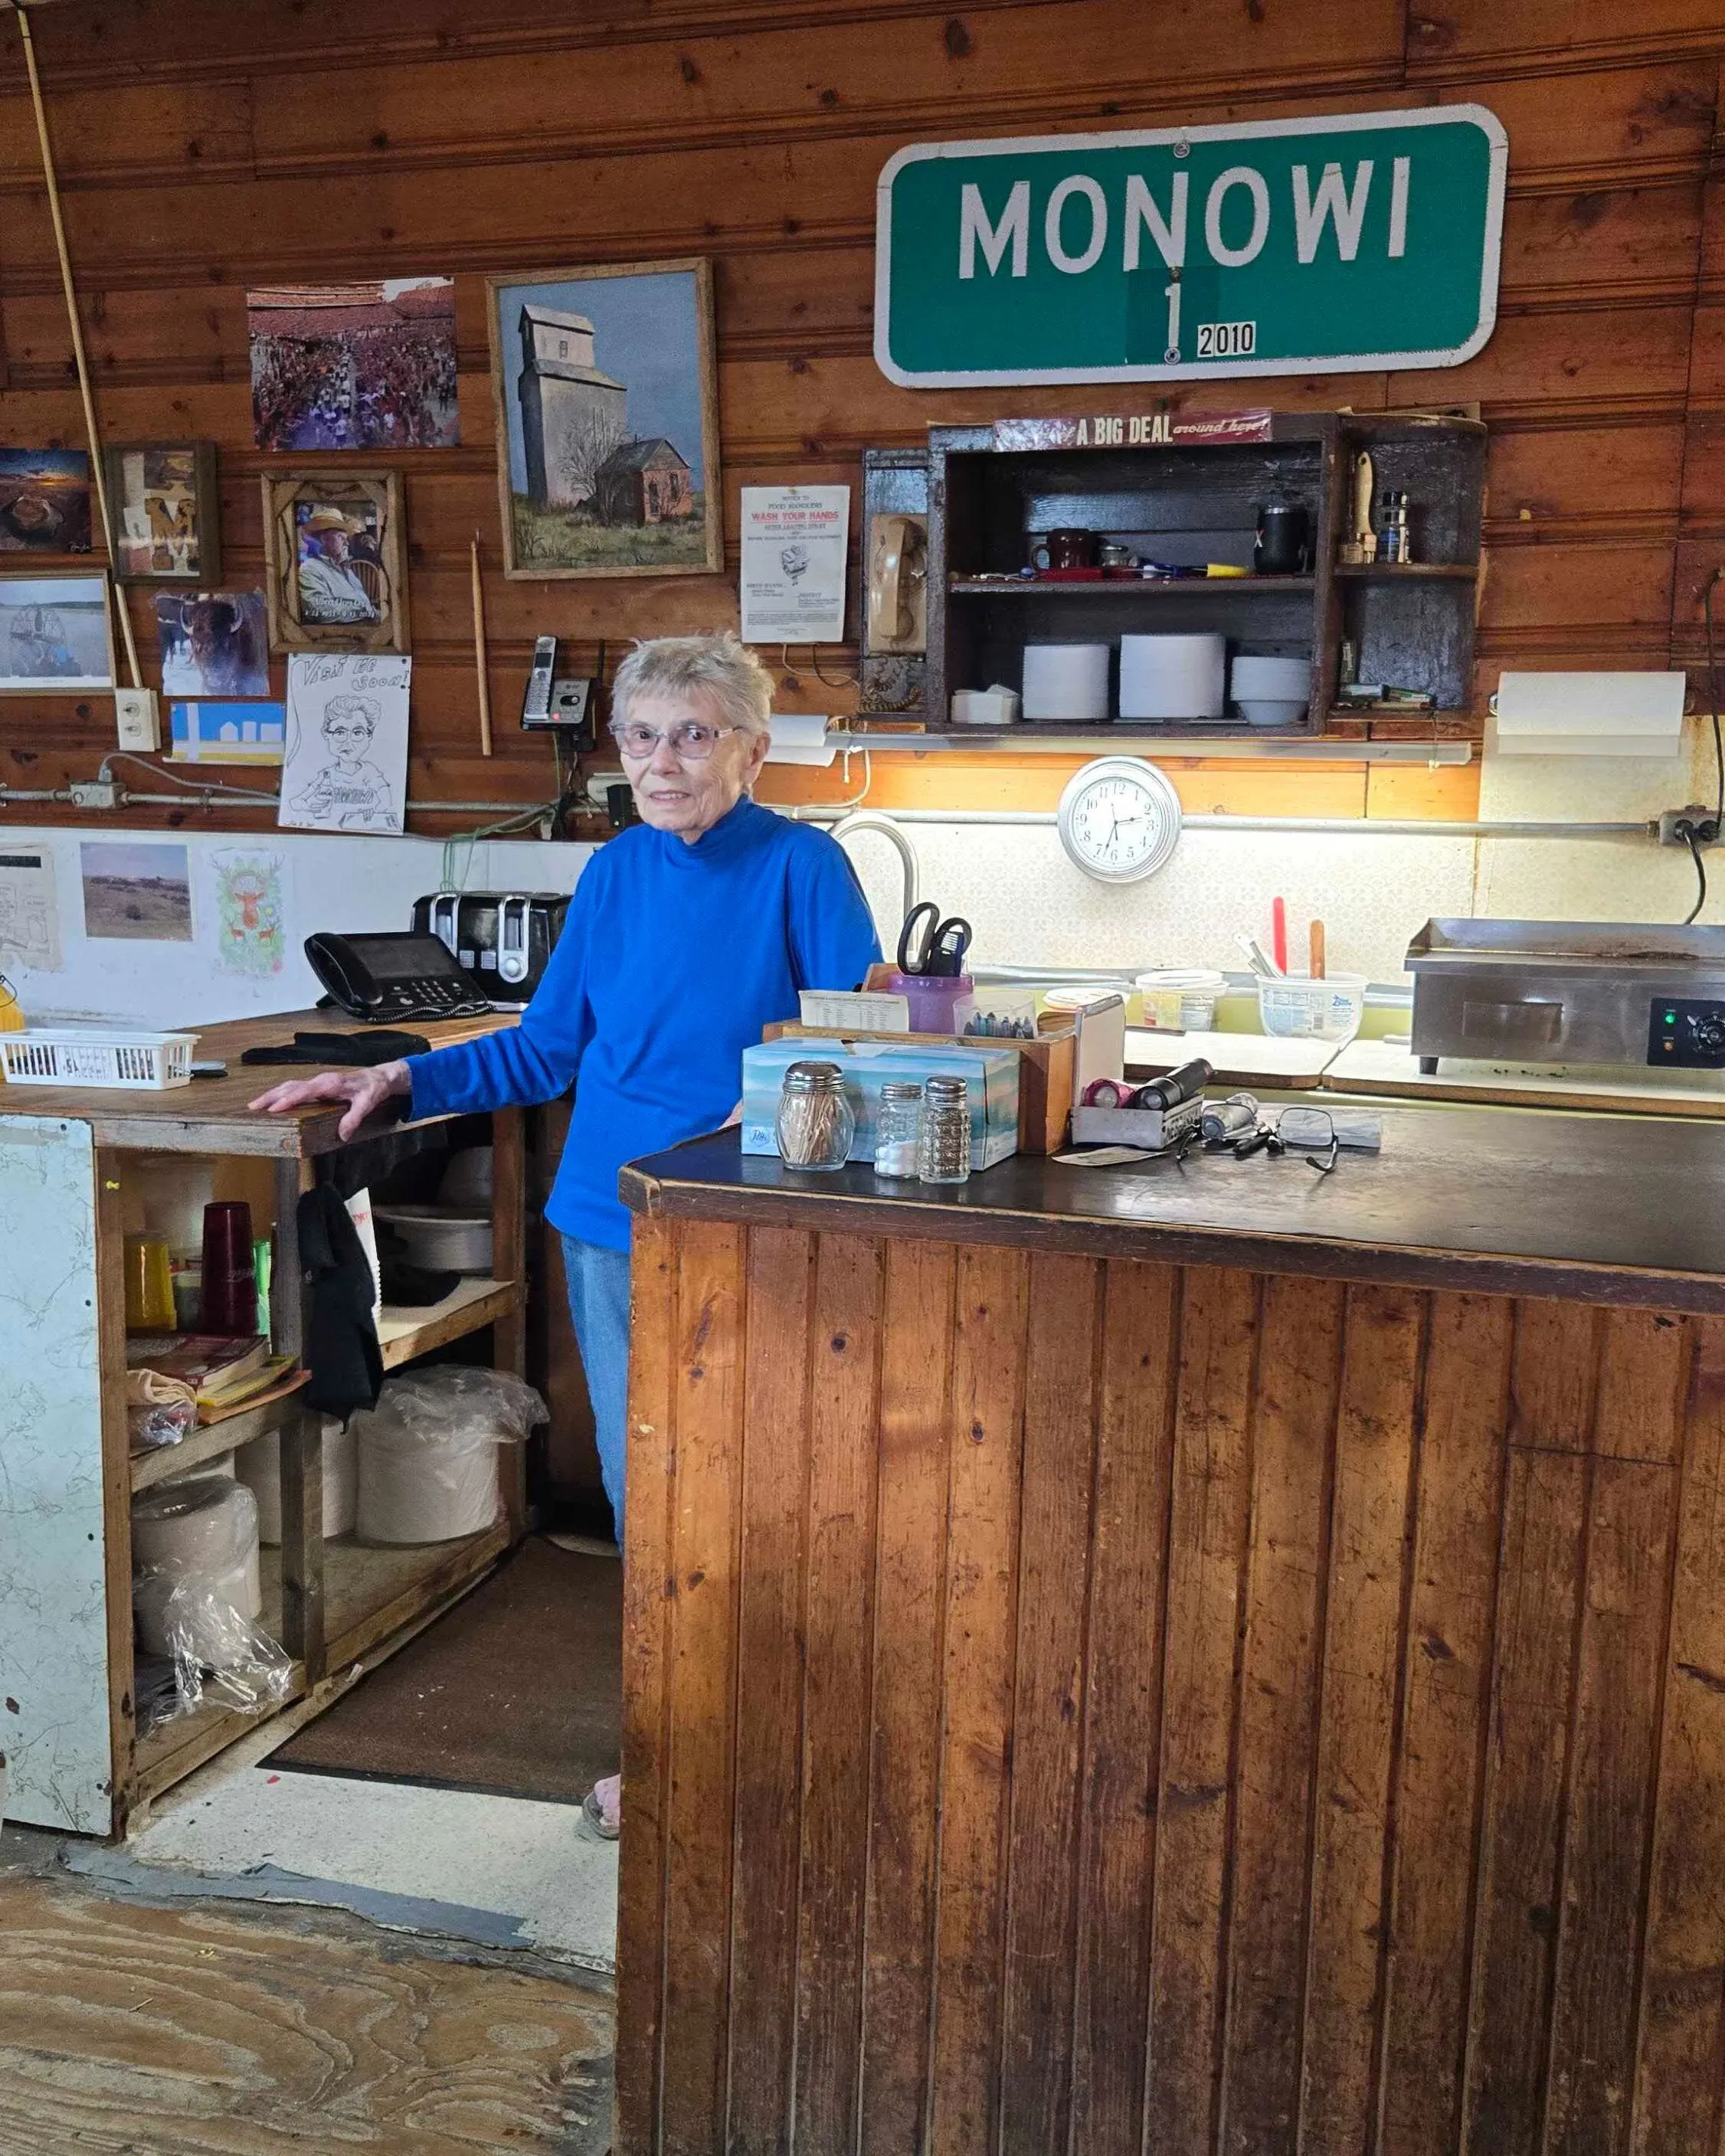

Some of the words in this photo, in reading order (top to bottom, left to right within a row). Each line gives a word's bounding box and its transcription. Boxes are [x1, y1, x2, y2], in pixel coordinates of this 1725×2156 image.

[959, 156, 1410, 279] MONOWI
[1165, 283, 1181, 348] 1
[1200, 323, 1253, 355] 2010
[1076, 418, 1088, 447] A
[1094, 417, 1124, 445] BIG
[1129, 415, 1173, 444] DEAL
[1173, 419, 1225, 434] around
[751, 512, 778, 521] WASH
[783, 512, 807, 521] YOUR
[809, 511, 839, 521] HANDS
[1099, 787, 1108, 798] 11
[1114, 783, 1126, 795] 12
[1087, 799, 1098, 810] 10
[1144, 803, 1151, 815] 2
[1080, 813, 1087, 826] 9
[1146, 820, 1154, 831] 3
[1084, 829, 1091, 842] 8
[1096, 843, 1103, 856] 7
[1111, 849, 1118, 862] 6
[1127, 846, 1134, 858] 5
